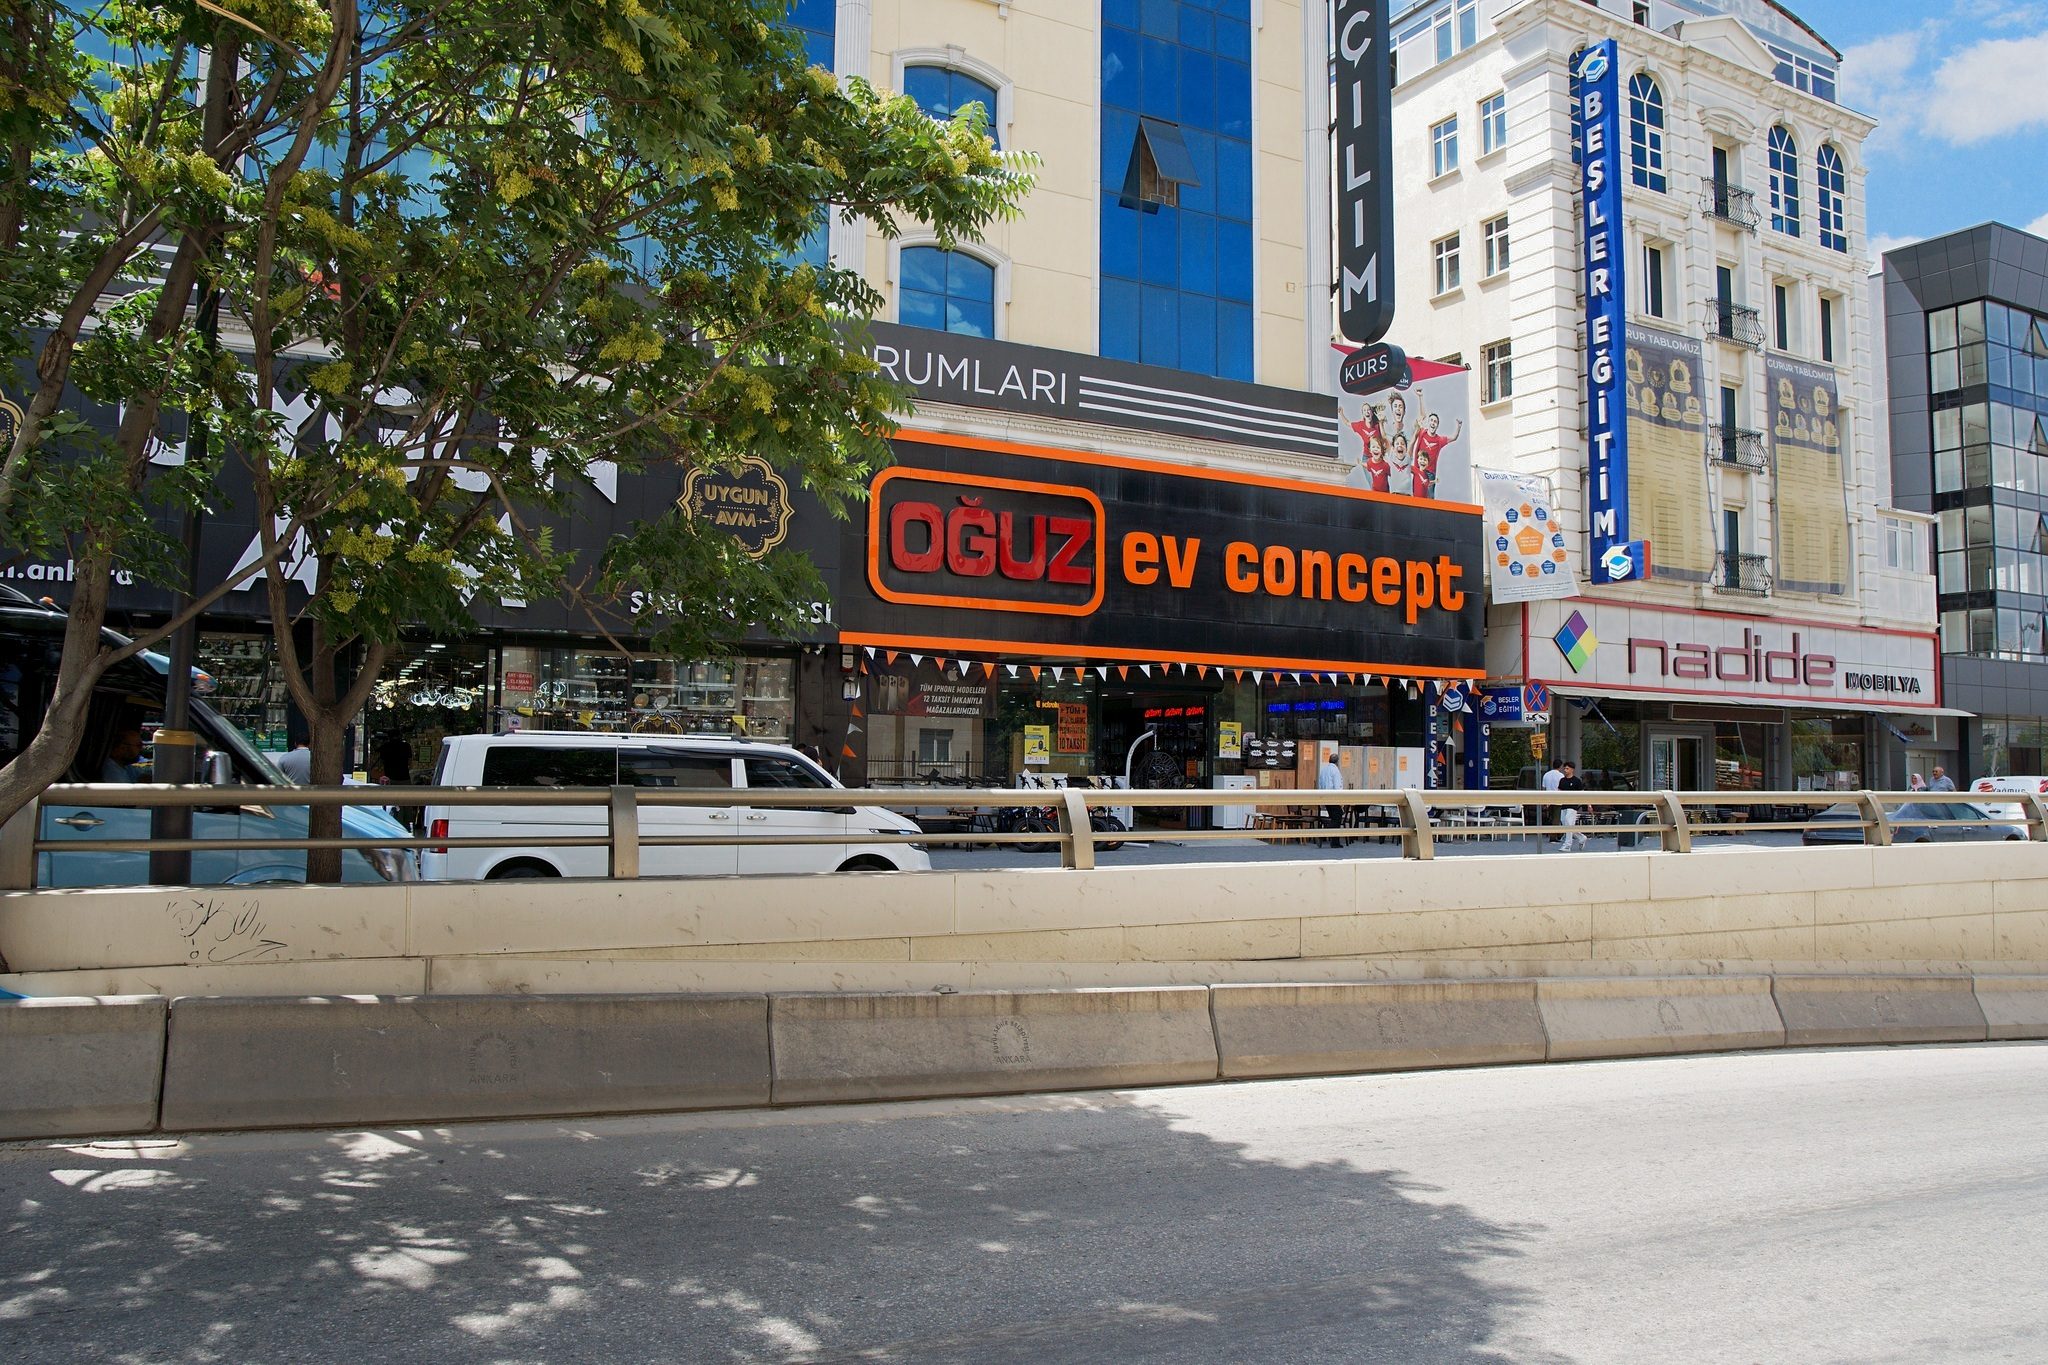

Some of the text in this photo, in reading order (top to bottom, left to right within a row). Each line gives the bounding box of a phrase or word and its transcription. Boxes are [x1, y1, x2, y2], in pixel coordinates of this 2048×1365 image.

[1337, 0, 1378, 313] ÇILIM
[1583, 90, 1616, 540] BEŞLER EĞİTİM
[1625, 328, 1701, 355] RUR TABLOMUZ
[860, 343, 1067, 406] RUMLARI
[1345, 354, 1388, 383] KURS
[1766, 358, 1835, 383] GURUR TABLOMUZ
[704, 483, 769, 506] UYGUN
[715, 510, 757, 528] AVM
[889, 495, 1466, 626] OĞUZ ev concept
[1628, 627, 1837, 687] nadide
[919, 683, 933, 692] TÜM
[1497, 696, 1520, 704] BEŞLER
[1498, 704, 1520, 713] EĞİTİM
